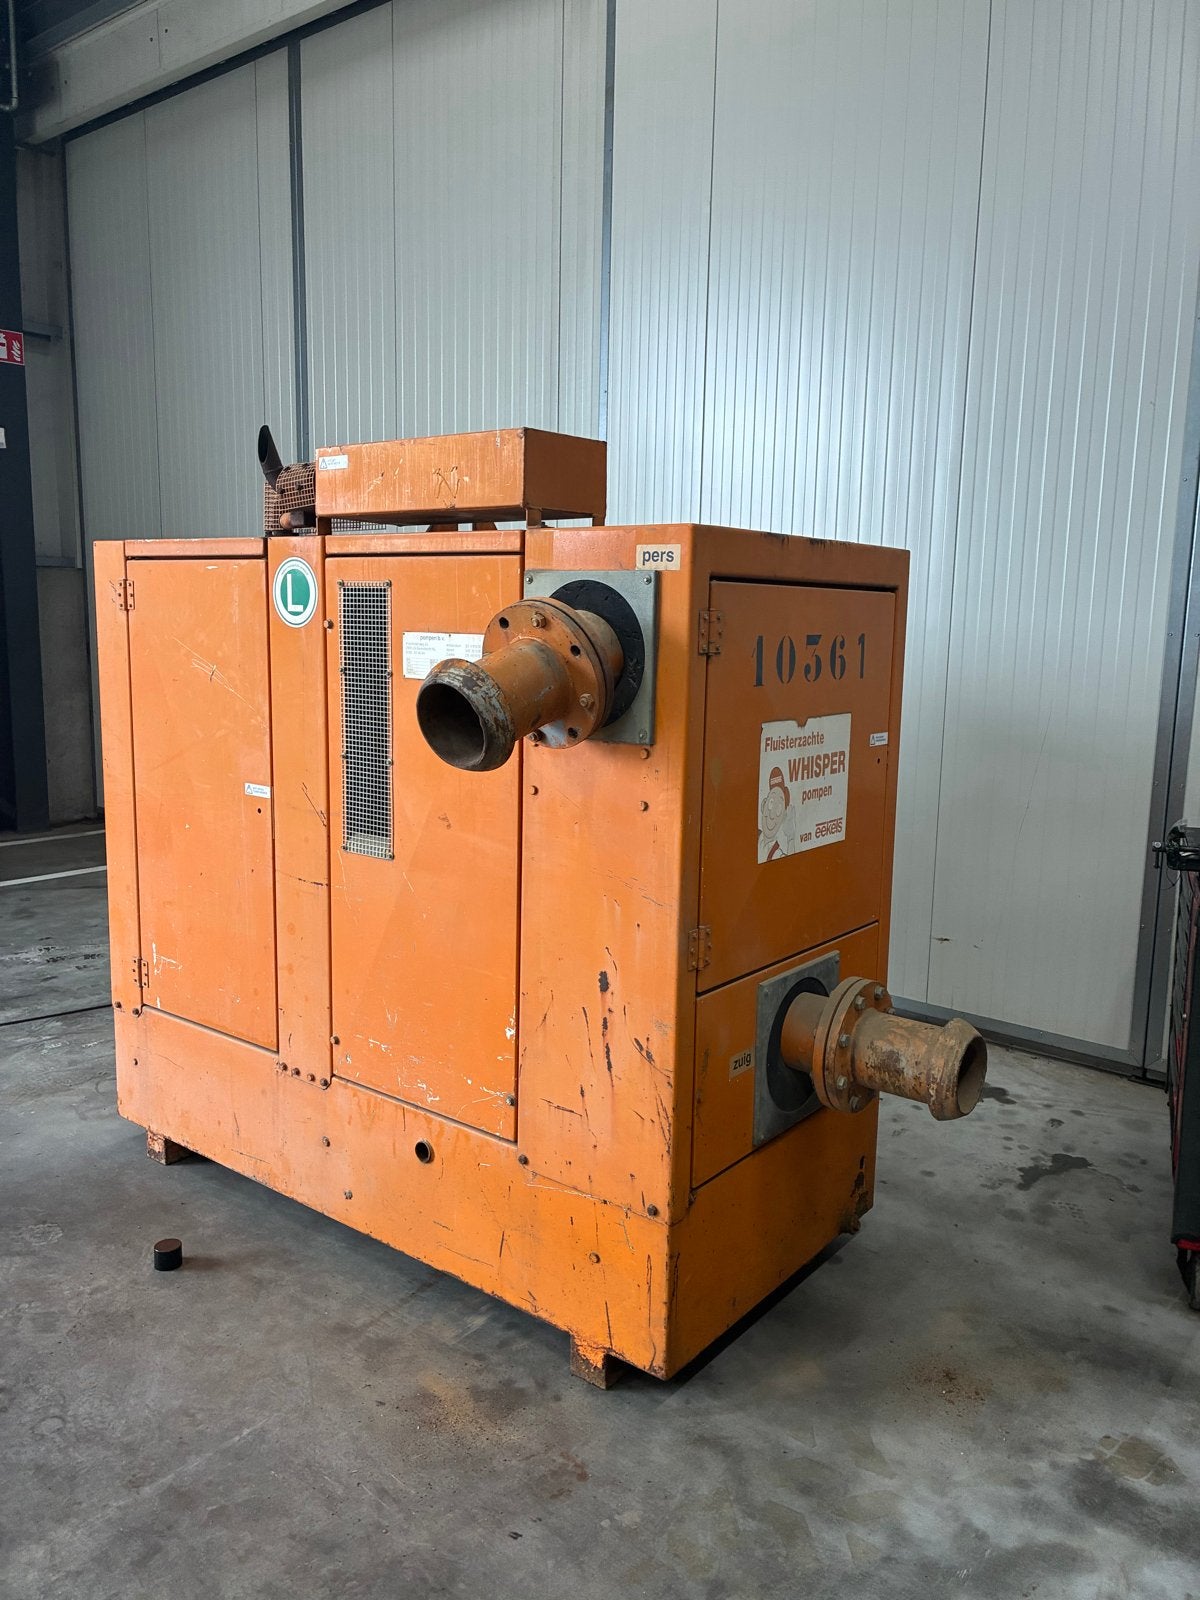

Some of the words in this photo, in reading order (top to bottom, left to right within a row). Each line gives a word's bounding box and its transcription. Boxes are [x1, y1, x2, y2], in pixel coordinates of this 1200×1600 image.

[642, 550, 675, 566] pers
[286, 573, 304, 613] L
[751, 632, 866, 687] 10361
[764, 731, 825, 753] Fluisterzachte
[788, 750, 846, 783] WHISPER
[801, 784, 833, 805] pompen
[799, 832, 812, 843] van
[815, 818, 843, 839] eekels
[732, 1052, 752, 1071] zuig
